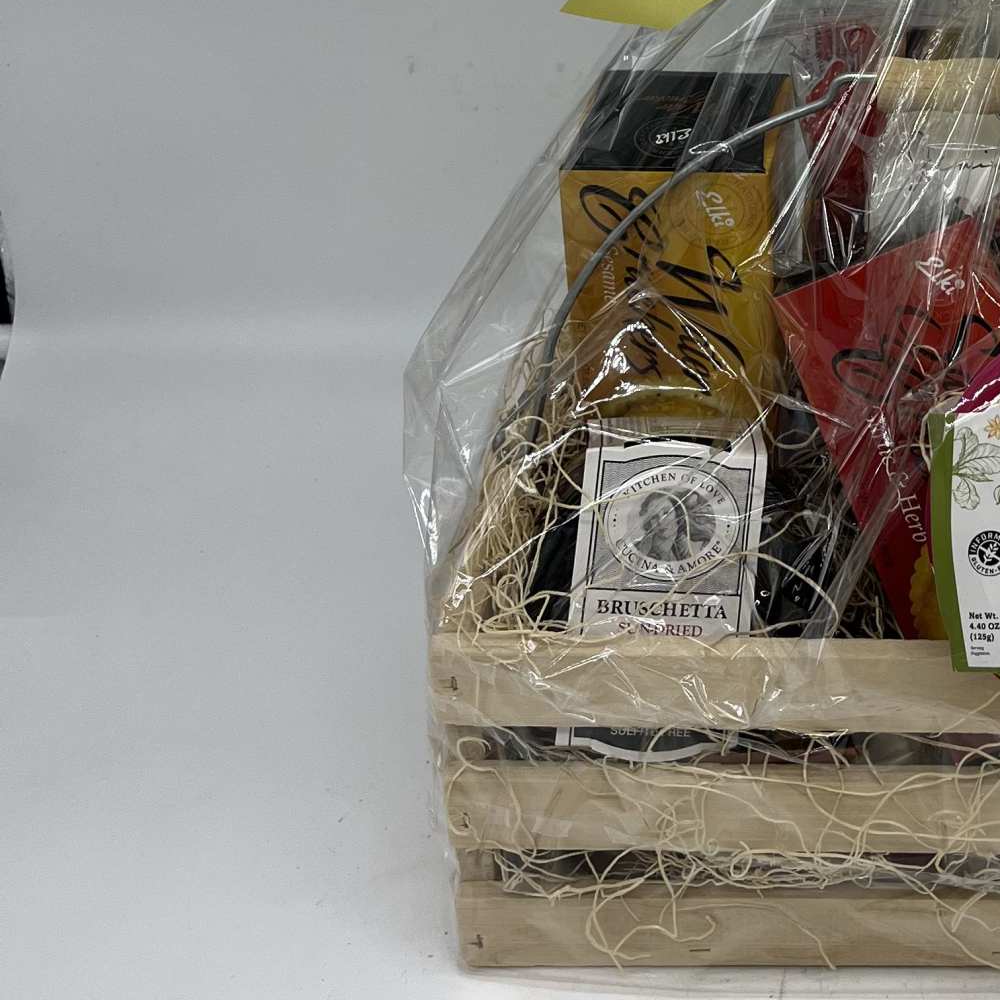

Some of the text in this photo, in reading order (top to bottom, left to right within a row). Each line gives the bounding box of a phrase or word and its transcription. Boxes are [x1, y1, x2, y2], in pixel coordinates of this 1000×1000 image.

[695, 189, 735, 228] Elki
[700, 482, 725, 506] LOVE
[597, 600, 728, 619] BRUSCHETTA
[969, 612, 999, 620] Net Wt.
[969, 622, 1000, 631] 4.40 OZ
[969, 633, 995, 642] (125g)
